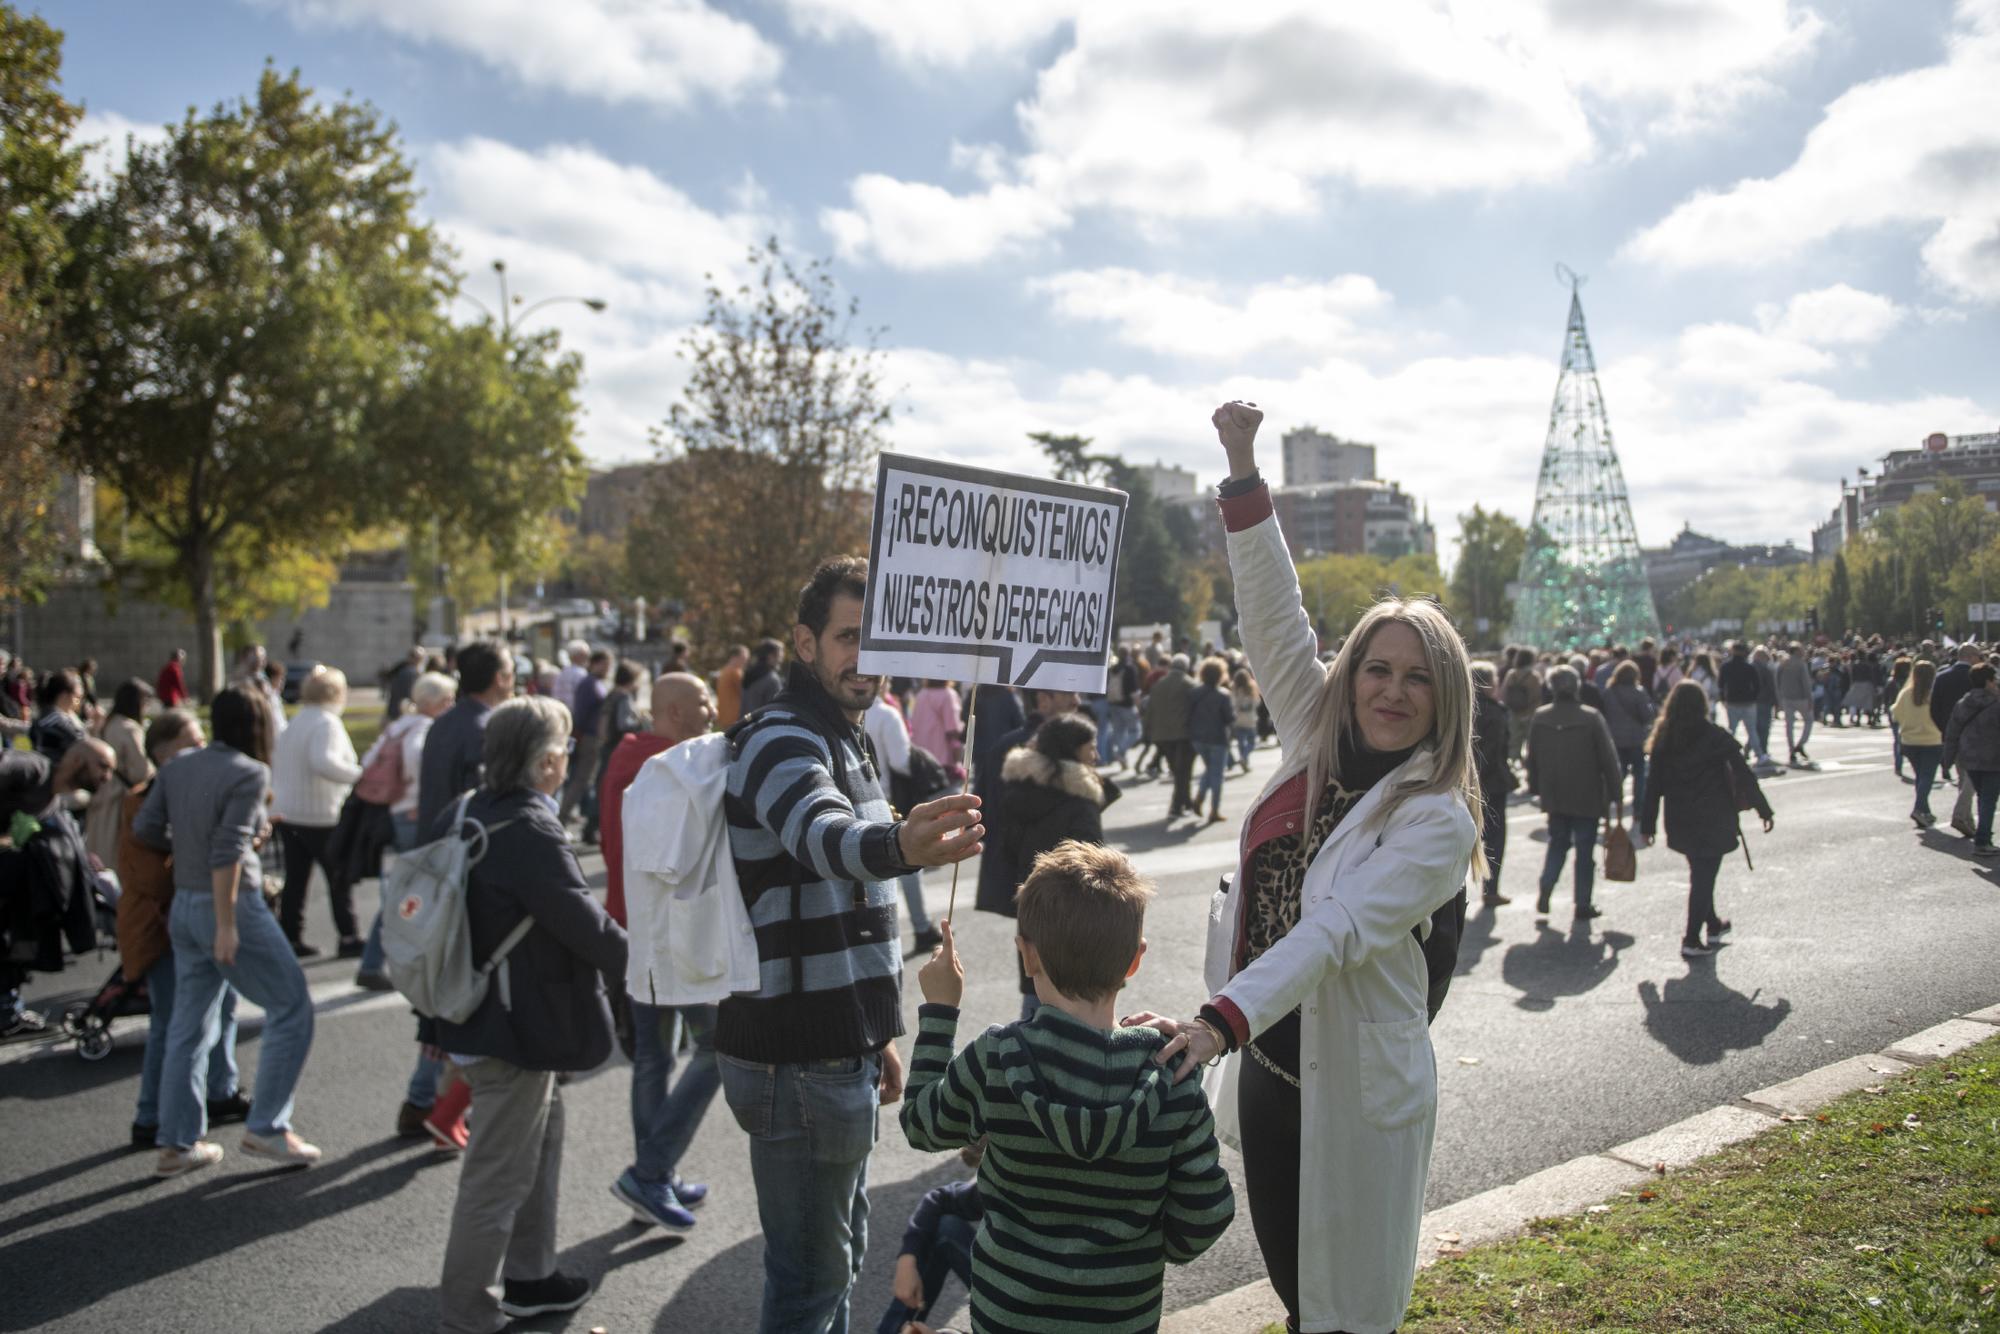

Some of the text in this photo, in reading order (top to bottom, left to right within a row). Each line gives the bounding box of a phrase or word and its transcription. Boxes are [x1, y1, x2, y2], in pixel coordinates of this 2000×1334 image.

[888, 484, 1110, 565] ¡RECONQUISTEMOS
[881, 573, 1102, 648] NUESTROS DERECHOS!
